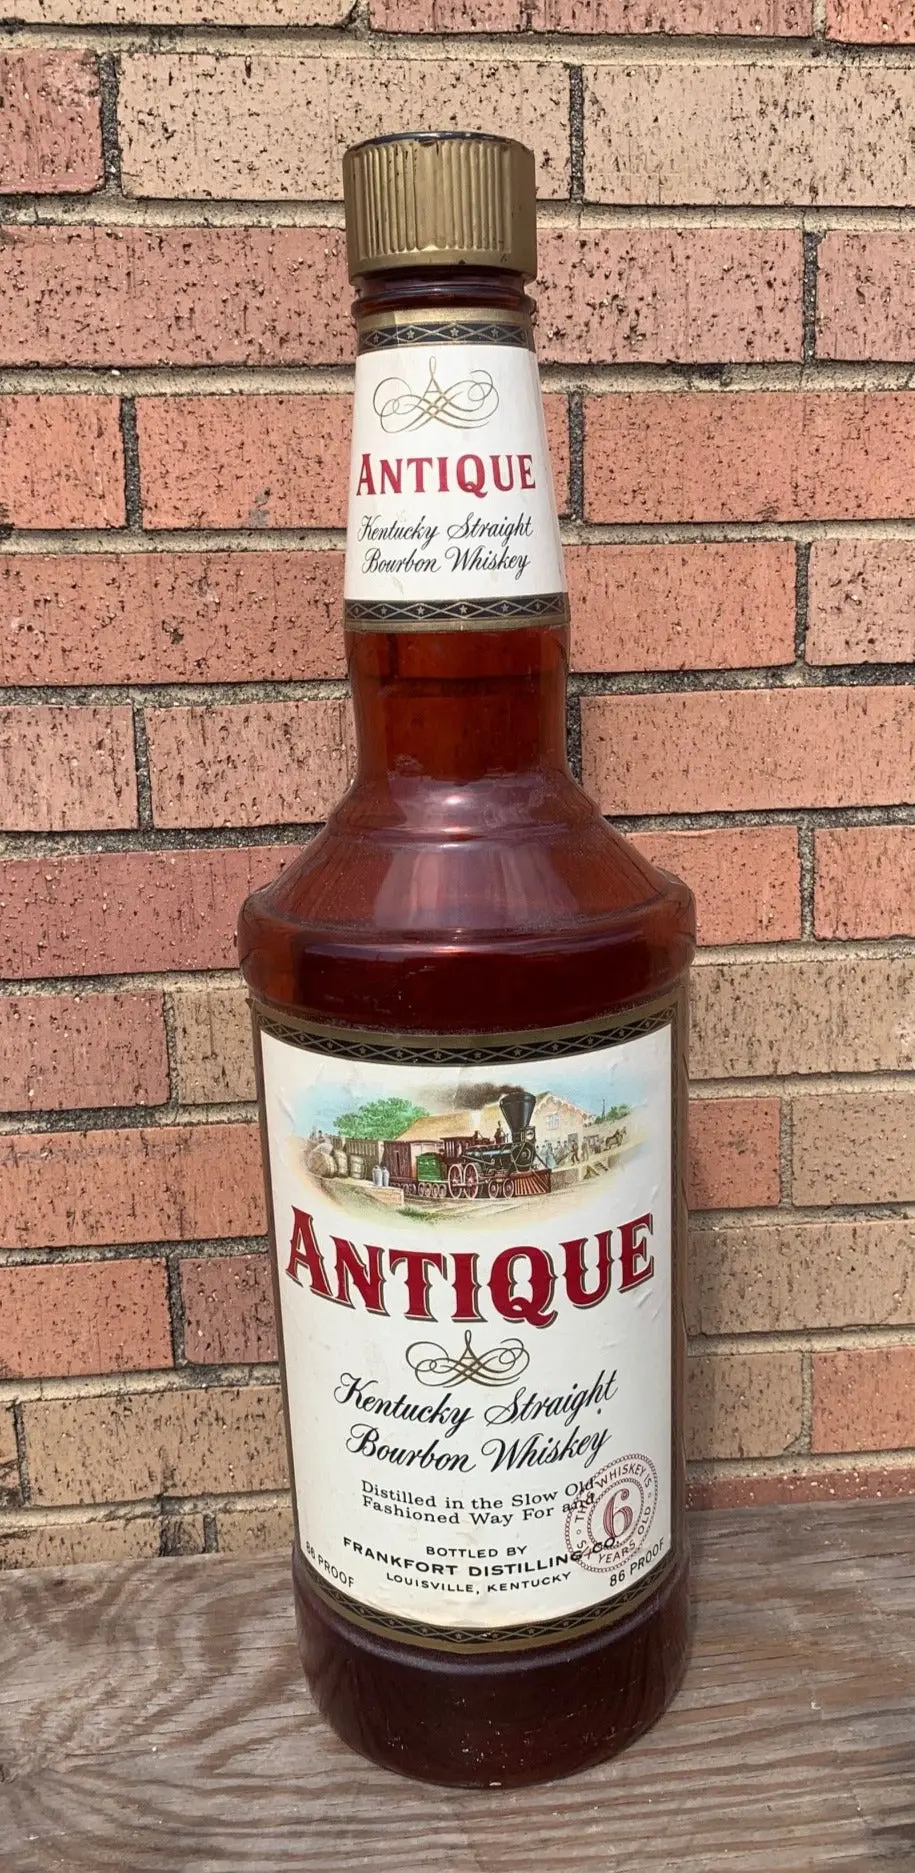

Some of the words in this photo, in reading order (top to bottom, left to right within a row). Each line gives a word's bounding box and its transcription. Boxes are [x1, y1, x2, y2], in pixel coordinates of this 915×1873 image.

[356, 453, 536, 498] ANTIQUE
[357, 515, 440, 550] Kentucky
[446, 512, 534, 547] Straight
[361, 548, 441, 573] Bourbon
[444, 545, 532, 580] Whiskey
[285, 1205, 655, 1329] ANTIQUE
[333, 1373, 474, 1438] Kentucky
[484, 1369, 618, 1427] Straight
[345, 1423, 476, 1473] Bourbon
[481, 1425, 612, 1473] Whiskey
[361, 1480, 437, 1508] Distilled
[445, 1496, 465, 1510] in
[471, 1497, 503, 1510] the
[512, 1491, 558, 1507] Slow
[565, 1477, 594, 1497] Old
[595, 1463, 647, 1488] WHISKEY
[643, 1475, 653, 1489] IS
[362, 1494, 460, 1524] Fashioned
[469, 1512, 514, 1527] Way
[522, 1507, 554, 1521] For
[562, 1492, 595, 1513] and
[602, 1488, 634, 1538] 6
[343, 1536, 458, 1576] FRANKFORT
[469, 1550, 583, 1577] DISTILLING
[592, 1536, 620, 1554] CO.
[426, 1546, 498, 1559] BOTTLED
[506, 1545, 528, 1557] BY
[598, 1539, 637, 1564] YEARS
[637, 1506, 651, 1536] OLD
[305, 1540, 316, 1560] 86
[317, 1554, 355, 1588] PROOF
[386, 1572, 481, 1595] LOUISVILLE,
[487, 1571, 572, 1593] KENTUCKY
[609, 1569, 626, 1588] 86
[629, 1536, 665, 1576] PROOF
